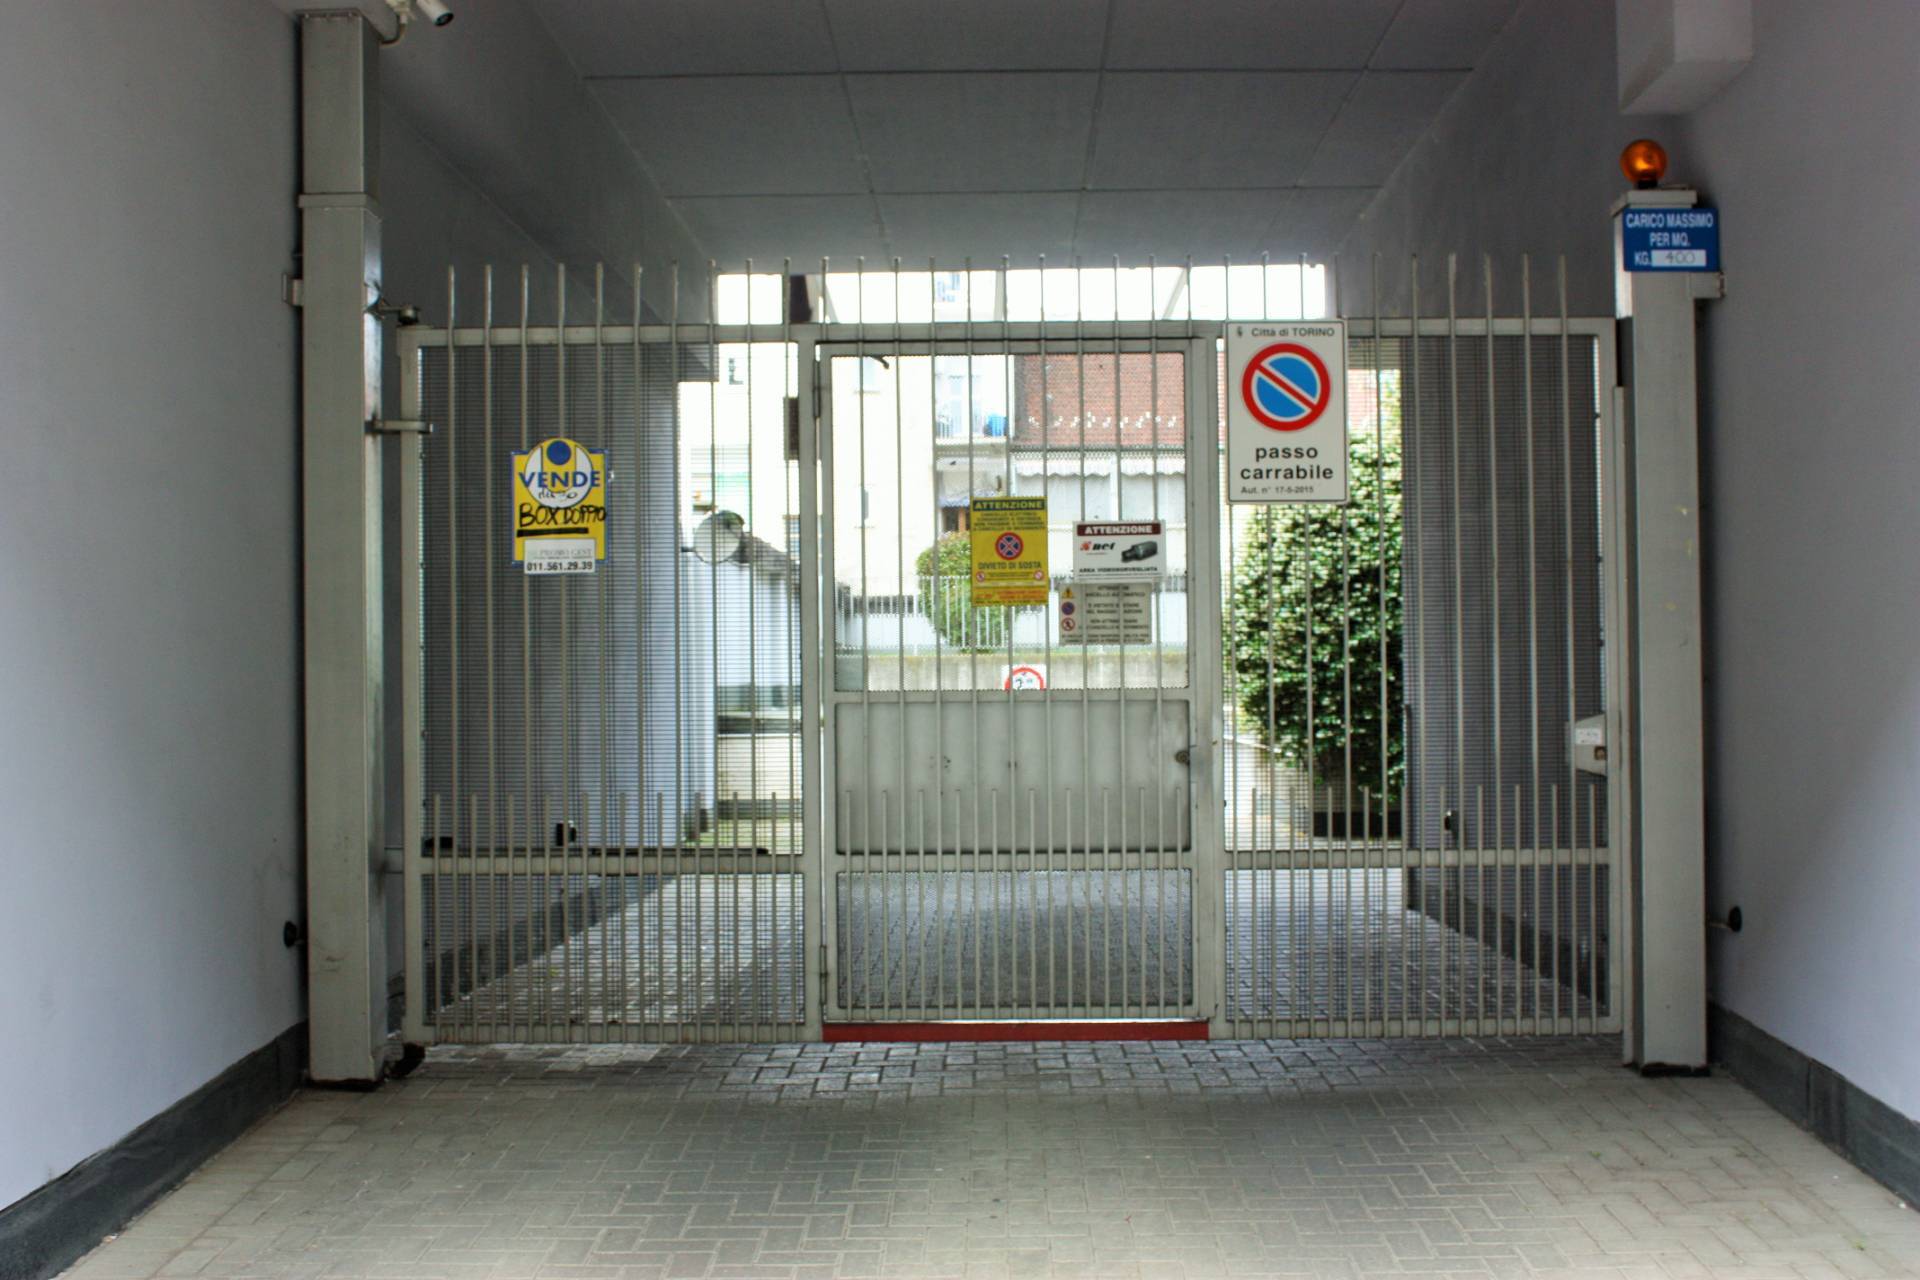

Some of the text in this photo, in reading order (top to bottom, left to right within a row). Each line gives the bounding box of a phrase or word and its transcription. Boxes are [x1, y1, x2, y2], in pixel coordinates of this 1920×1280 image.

[1626, 213, 1713, 228] CARICO MASSIMO
[1650, 232, 1670, 246] PER
[1279, 327, 1289, 337] di
[1292, 327, 1335, 337] TORINO
[1255, 447, 1318, 462] passo
[518, 471, 601, 488] VENDE
[1240, 465, 1334, 480] carrabile
[975, 501, 1042, 510] ATTENZIONE
[519, 503, 558, 527] BOX
[1084, 525, 1153, 535] ATTENZIONE
[978, 562, 1007, 570] DIVIETO
[1018, 561, 1042, 569] SOSTA
